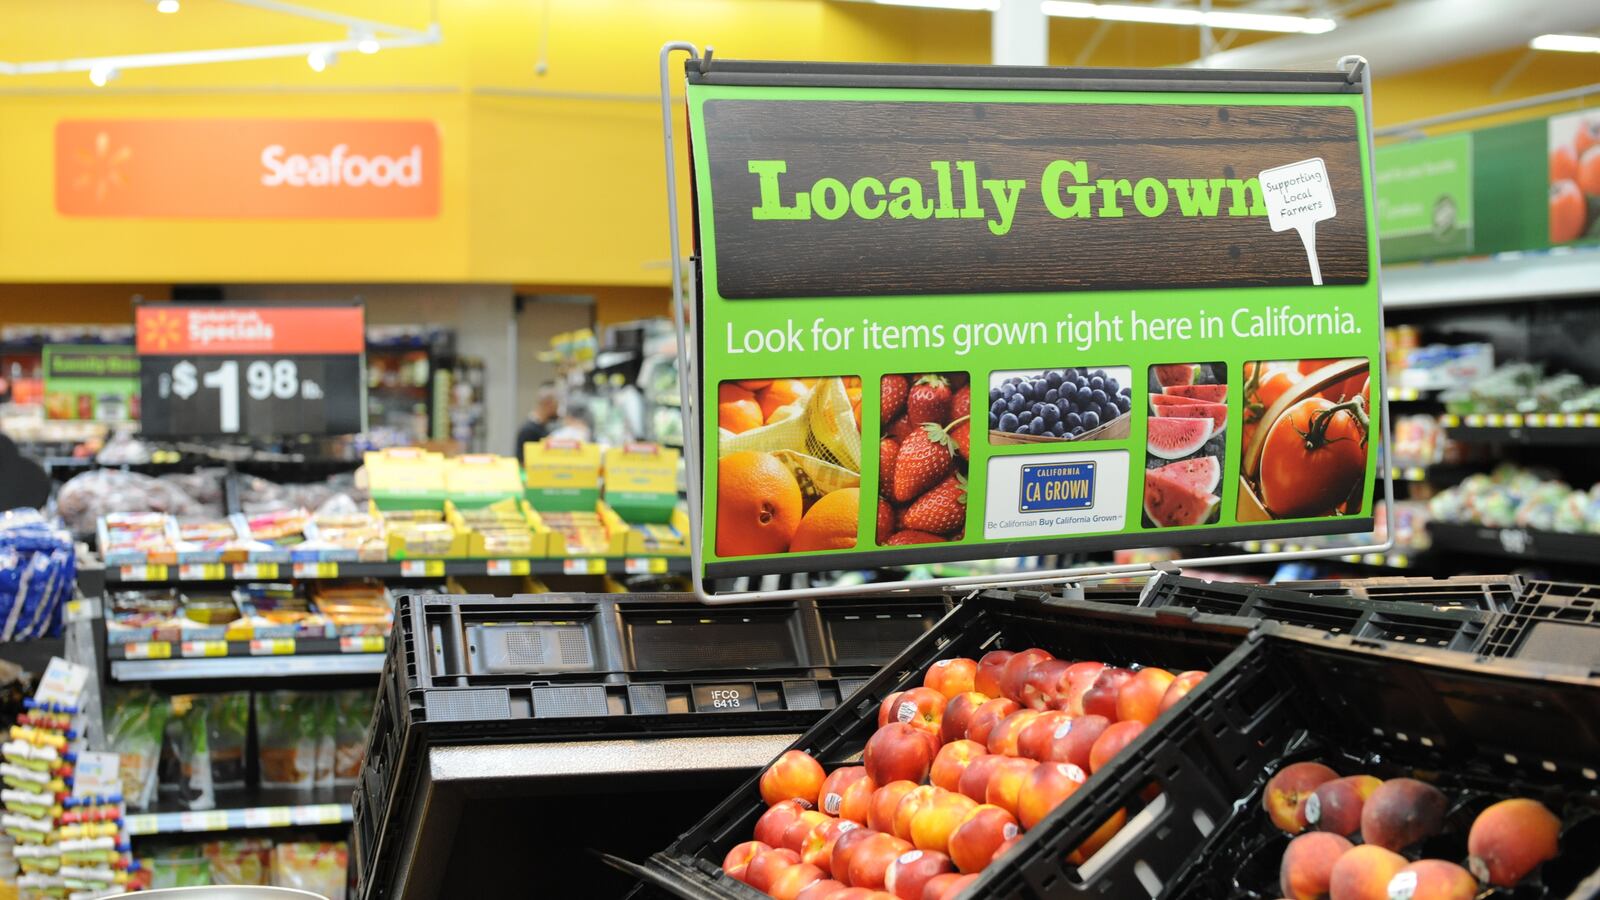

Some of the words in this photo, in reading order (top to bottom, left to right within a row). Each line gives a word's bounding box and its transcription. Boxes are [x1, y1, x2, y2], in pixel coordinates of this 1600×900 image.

[260, 144, 422, 188] Seafood
[1266, 172, 1322, 194] Supporting
[747, 159, 1026, 236] Locally
[1041, 159, 1268, 219] Grown
[1284, 187, 1312, 204] Local
[1280, 201, 1323, 217] Farmers
[188, 322, 275, 345] Specials
[726, 318, 805, 354] Look
[811, 317, 855, 352] for
[862, 318, 945, 350] items
[952, 320, 1047, 356] grown
[1056, 311, 1123, 351] right
[1131, 309, 1192, 341] here
[1199, 309, 1224, 339] in
[1231, 305, 1362, 338] California.
[1037, 467, 1080, 477] CALIFORNIA
[1025, 482, 1041, 502] CA
[1045, 479, 1089, 501] GROWN
[987, 521, 998, 529] Be
[999, 519, 1038, 528] Californian
[1039, 518, 1054, 527] Buy
[1055, 515, 1091, 525] California
[1093, 514, 1117, 523] Grown
[711, 690, 740, 699] IFCO
[713, 699, 741, 708] 6413
